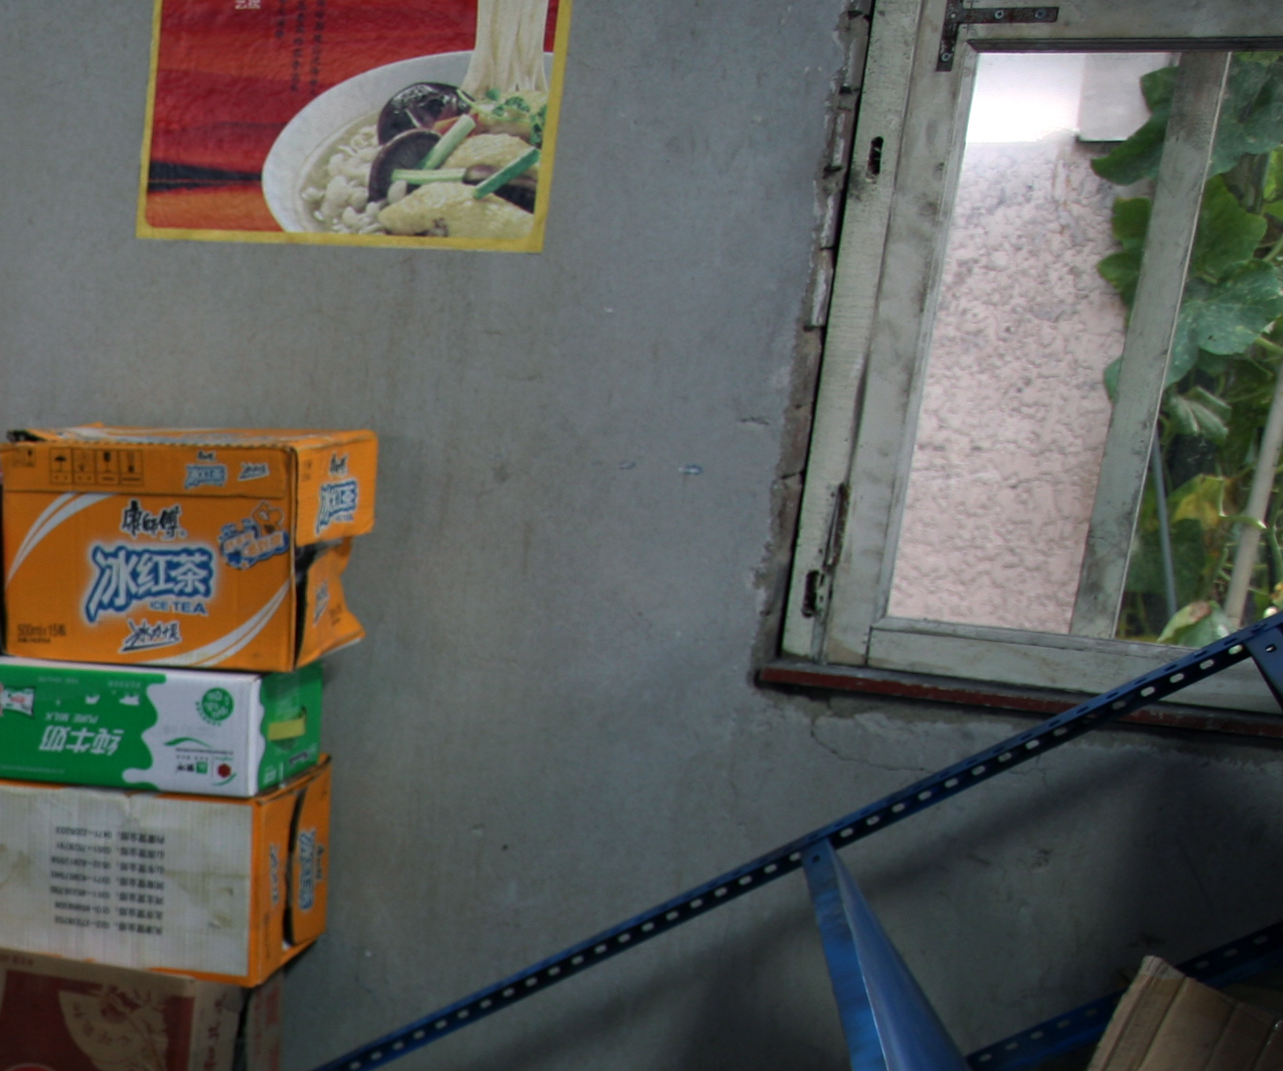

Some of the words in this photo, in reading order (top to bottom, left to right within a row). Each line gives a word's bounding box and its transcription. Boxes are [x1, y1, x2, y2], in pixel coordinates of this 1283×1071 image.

[122, 500, 183, 540] 康师傅
[86, 544, 216, 622] 冰红茶
[149, 601, 170, 613] ICE
[173, 601, 209, 616] TEA
[38, 724, 125, 756] 纯牛奶
